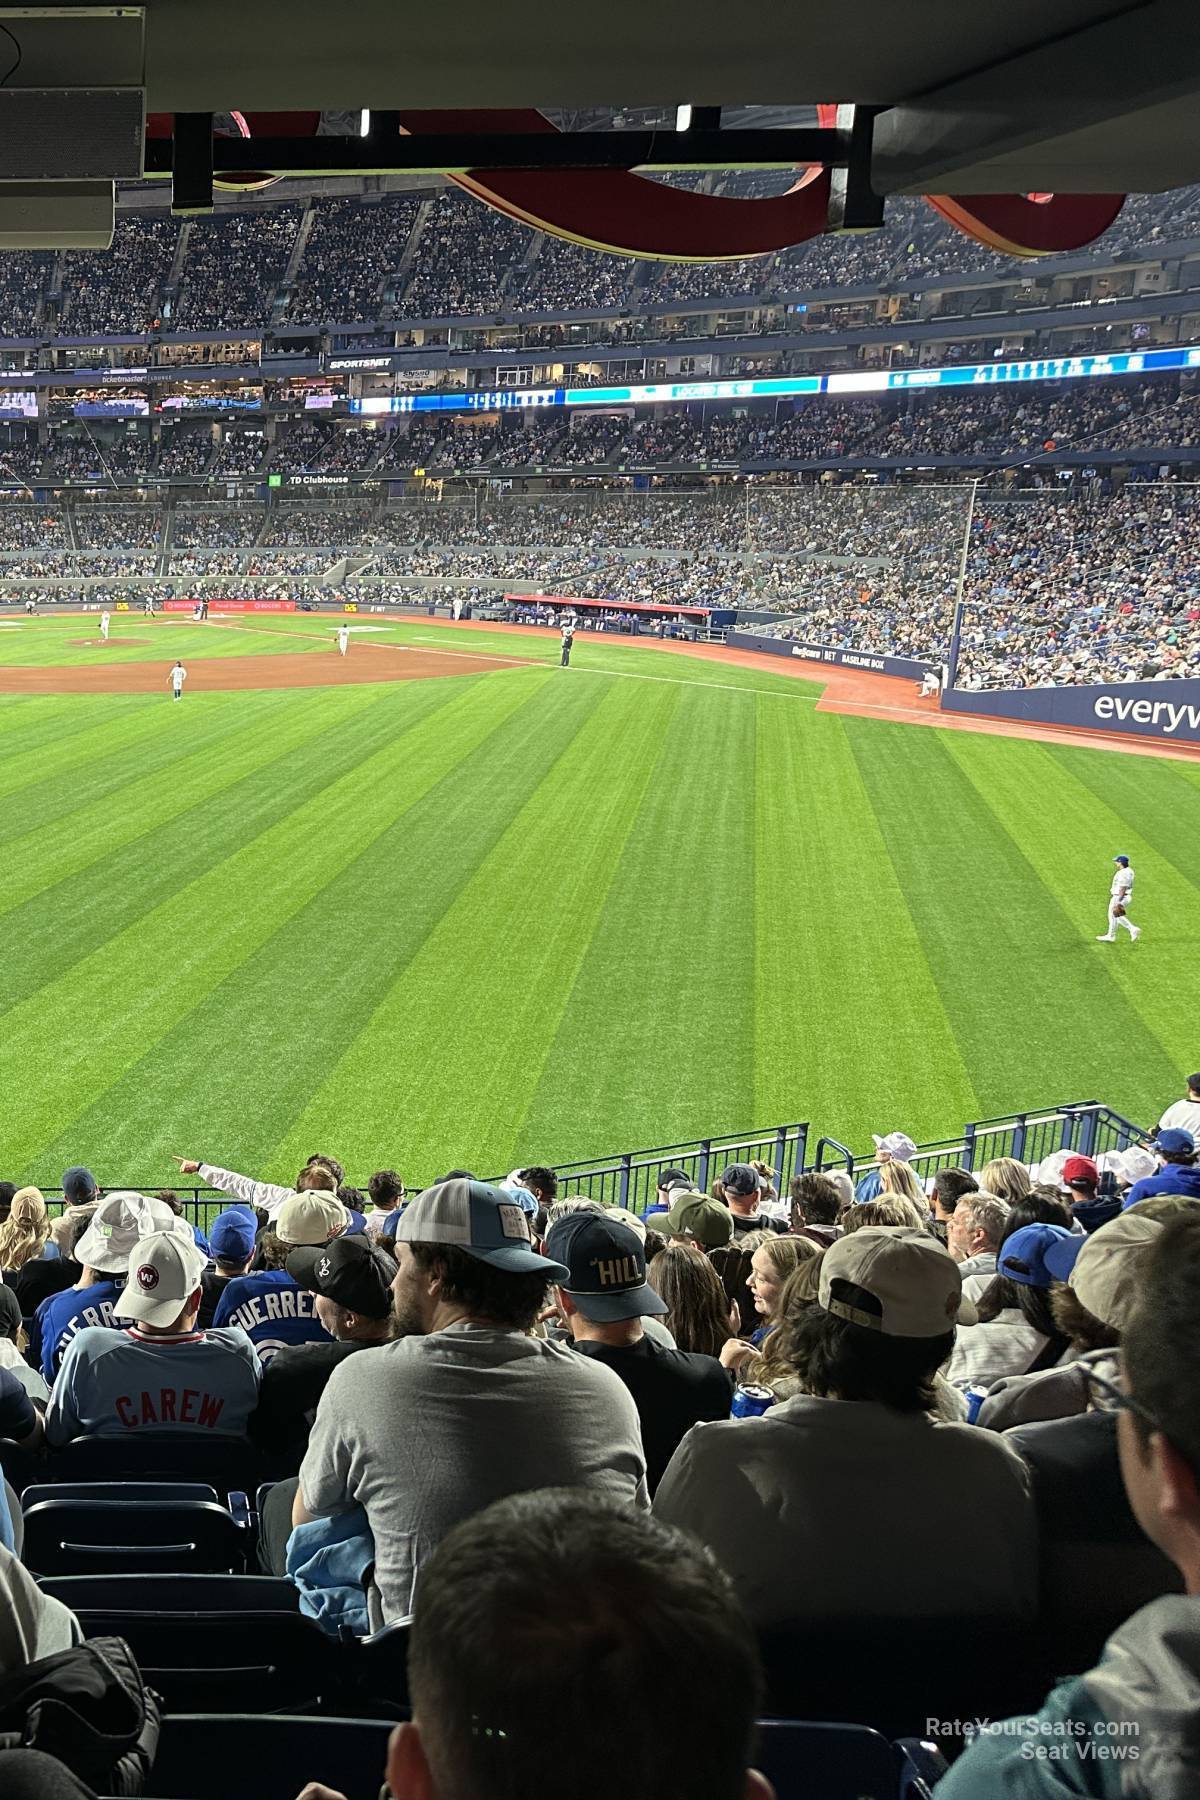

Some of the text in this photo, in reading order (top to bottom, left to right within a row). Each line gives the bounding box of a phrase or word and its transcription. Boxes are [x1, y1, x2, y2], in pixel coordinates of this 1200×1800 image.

[330, 358, 391, 369] SPORTSNET
[102, 375, 145, 383] ticketmaster
[290, 477, 301, 485] TD
[302, 476, 349, 484] Clubhouse
[824, 651, 836, 661] BET
[842, 654, 871, 667] BASELINE
[871, 659, 884, 669] BOX
[229, 1290, 319, 1331] GUERRE
[115, 1388, 225, 1429] CAREW
